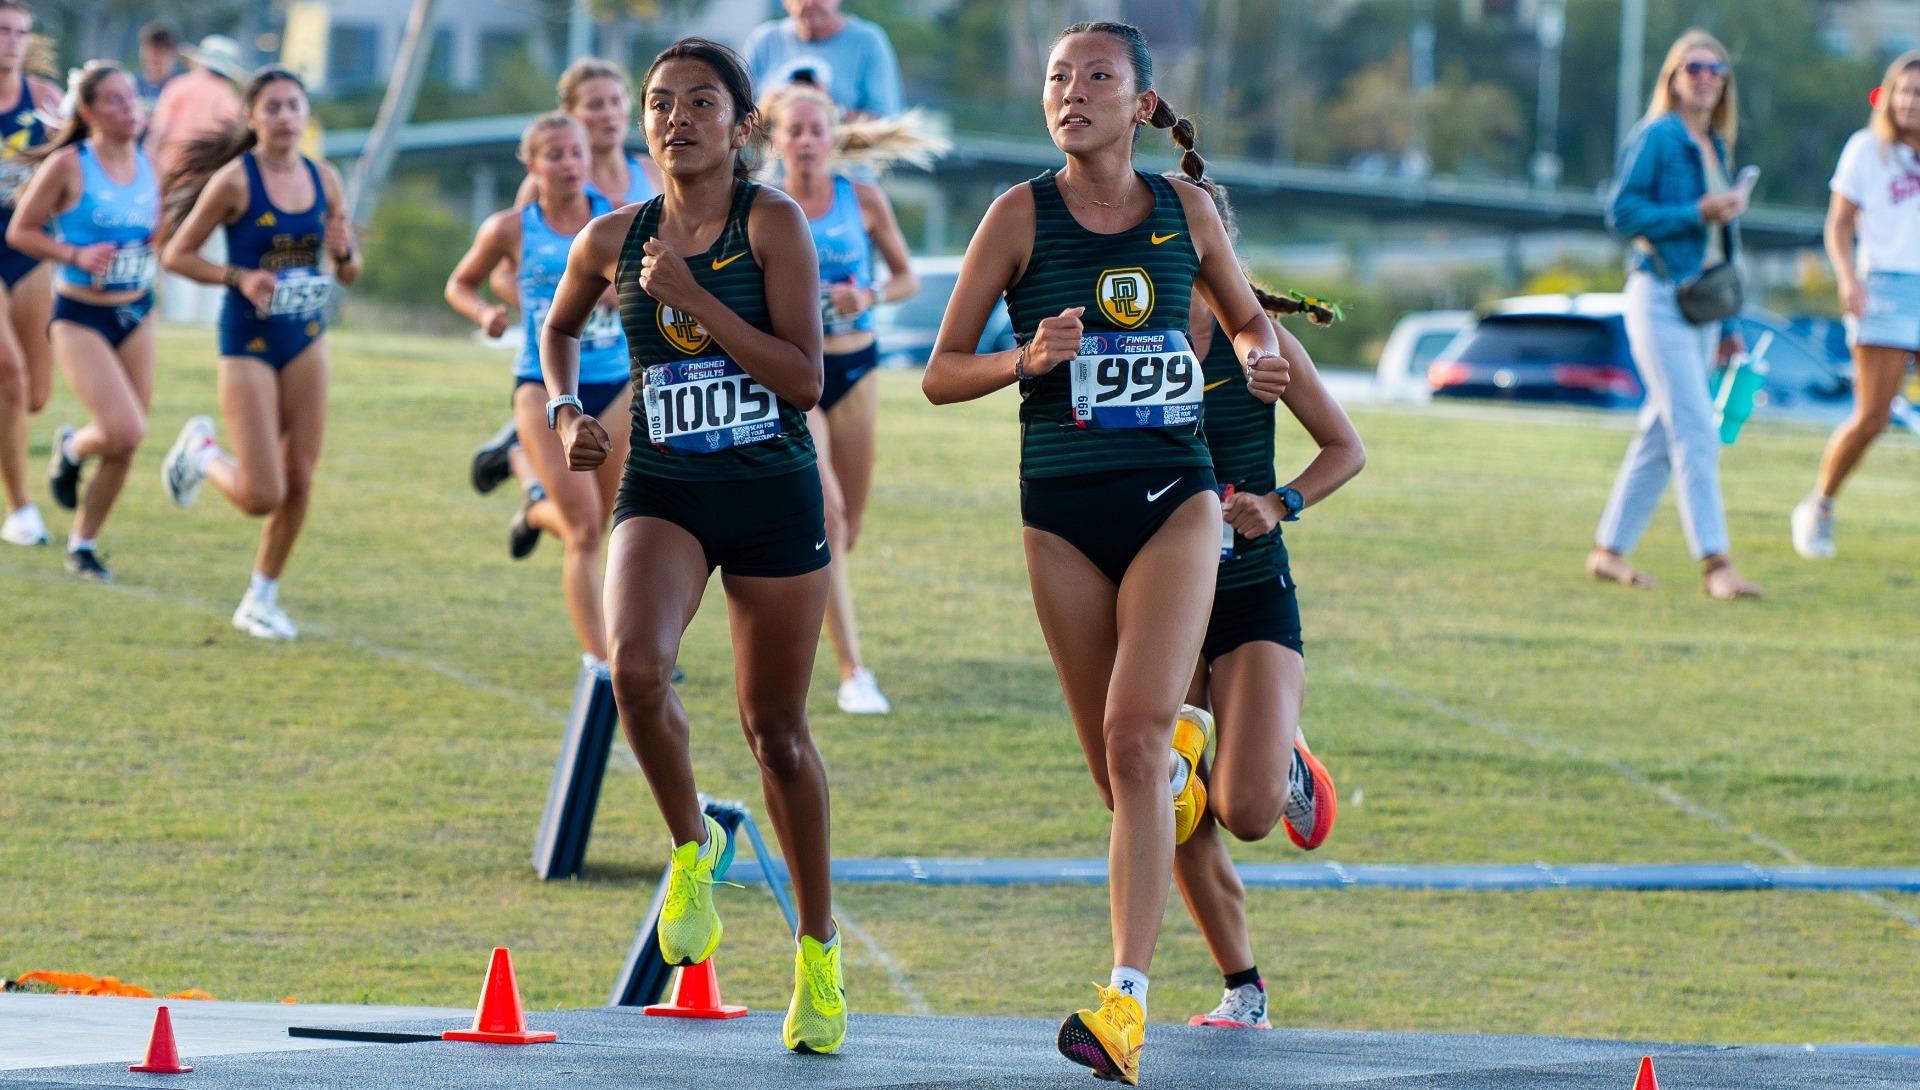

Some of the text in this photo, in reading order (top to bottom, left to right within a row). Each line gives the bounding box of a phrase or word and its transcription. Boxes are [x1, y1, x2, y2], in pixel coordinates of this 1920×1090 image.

[1126, 335, 1164, 344] FINISHED
[1124, 344, 1163, 353] RESULTS
[688, 360, 725, 371] FINISHED
[688, 369, 724, 380] RESULTS
[1095, 355, 1193, 403] 999
[659, 377, 770, 434] 1005
[1078, 396, 1088, 416] 999
[651, 416, 662, 441] 1005
[750, 423, 764, 431] SCAN
